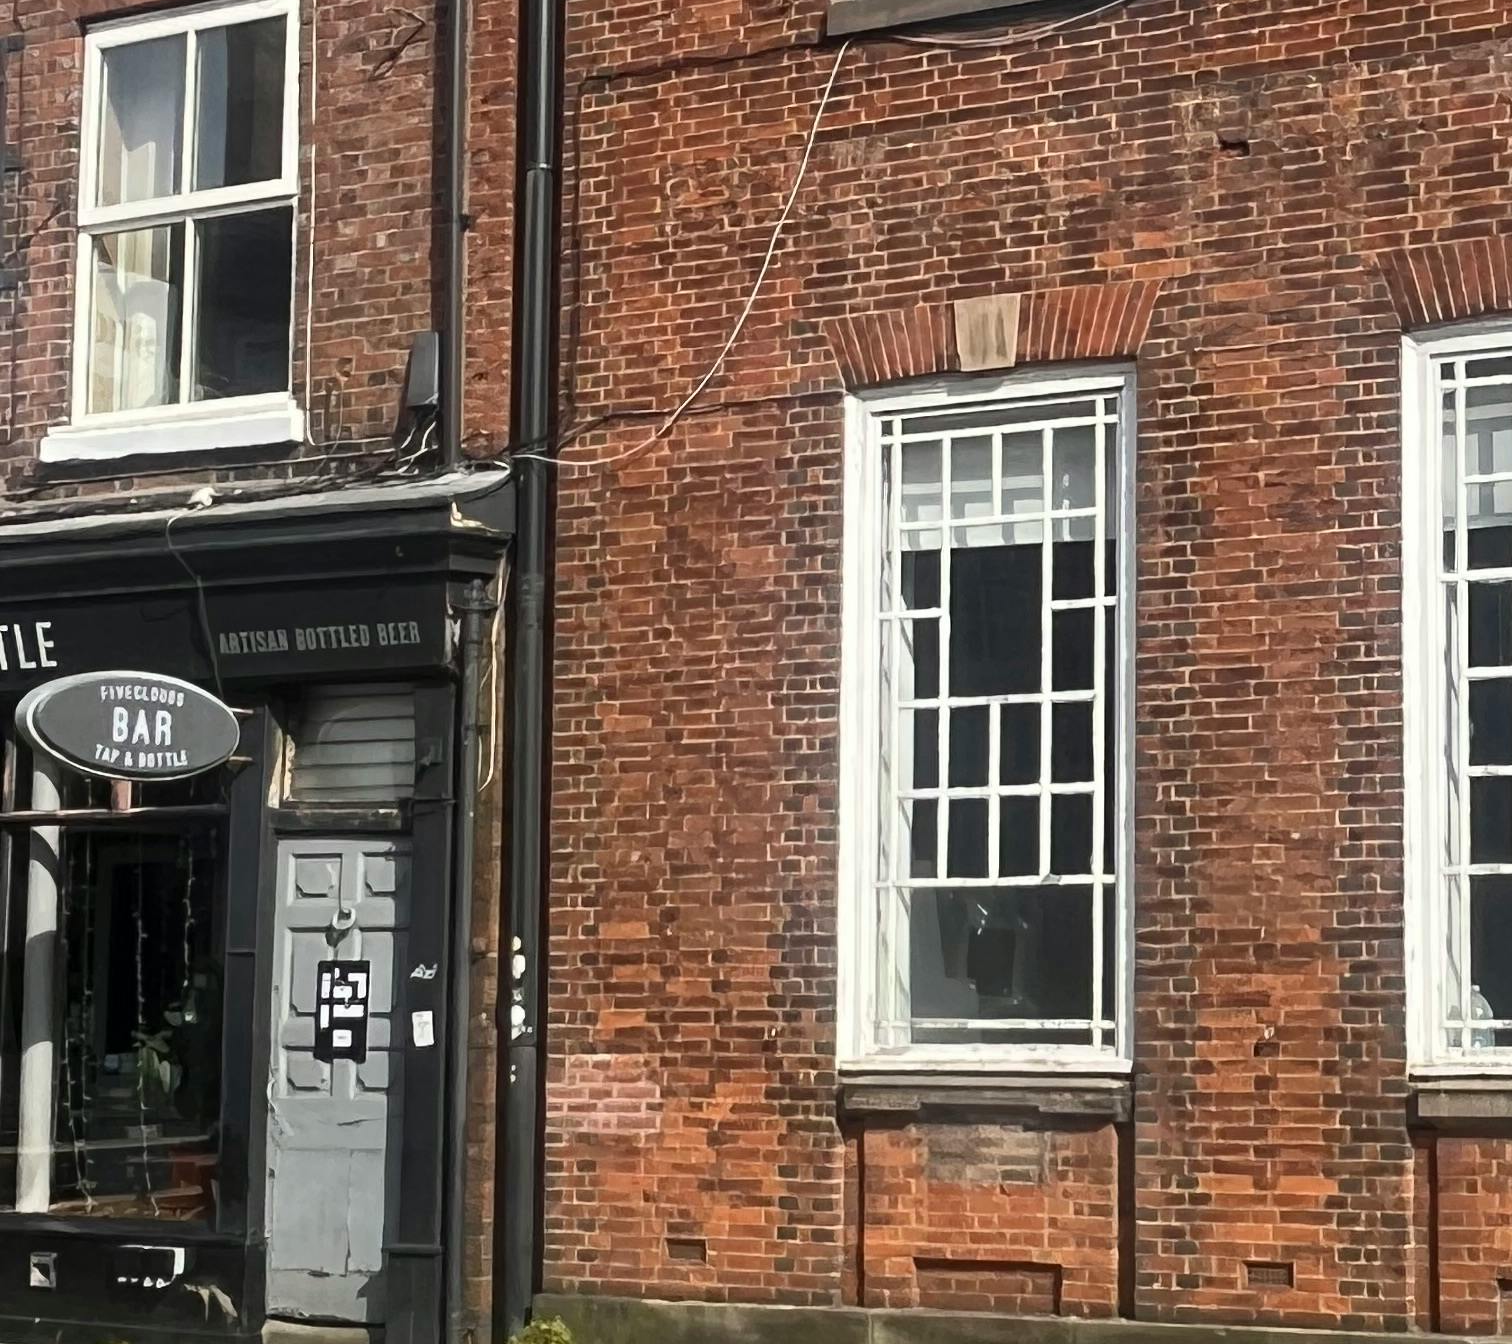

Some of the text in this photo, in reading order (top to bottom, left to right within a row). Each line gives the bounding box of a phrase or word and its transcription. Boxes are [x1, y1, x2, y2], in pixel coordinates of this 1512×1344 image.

[219, 621, 421, 654] ARTISAN BOTTLED BEER
[113, 706, 172, 745] BAR
[95, 743, 120, 763] TAP
[138, 749, 188, 768] BOTTLE
